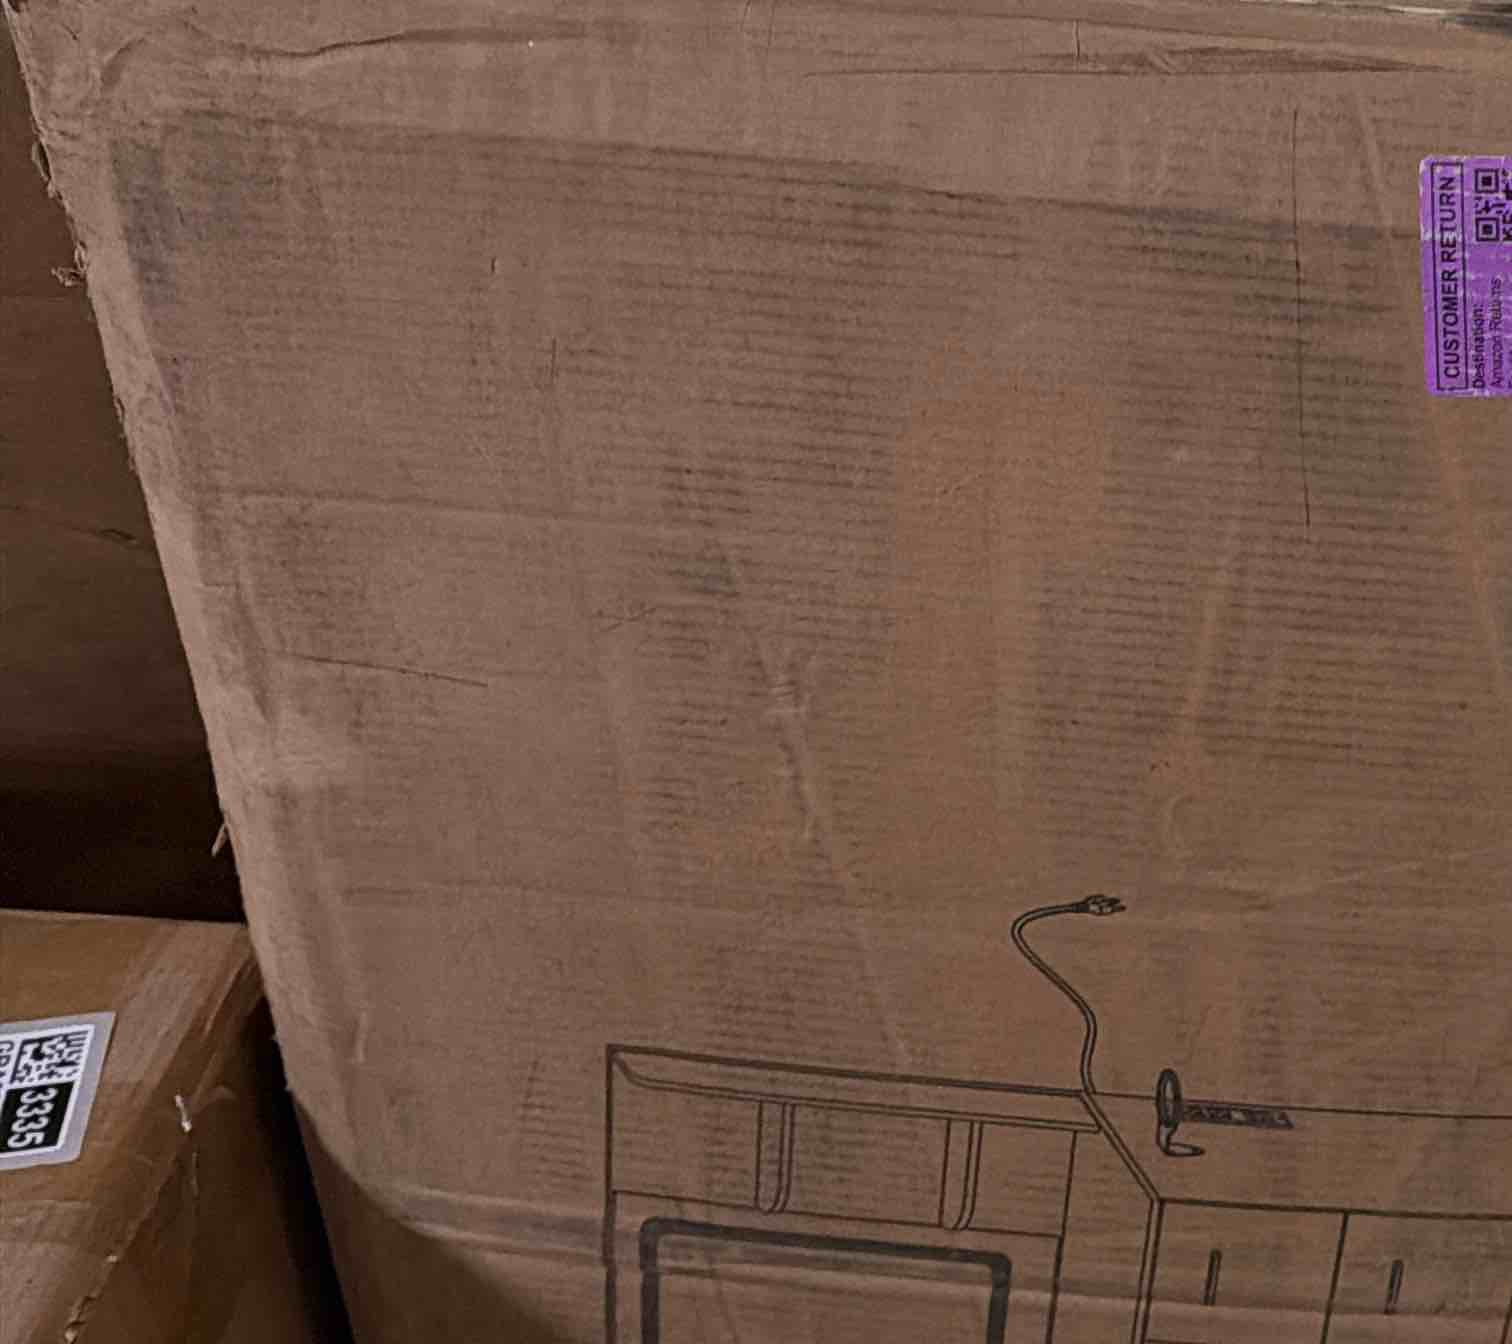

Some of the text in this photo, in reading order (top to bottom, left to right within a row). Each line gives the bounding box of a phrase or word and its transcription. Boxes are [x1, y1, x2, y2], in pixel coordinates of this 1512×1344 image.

[1437, 176, 1461, 379] CUSTOMER RETURN
[1471, 303, 1486, 389] Destination:
[8, 1086, 59, 1149] 3335
